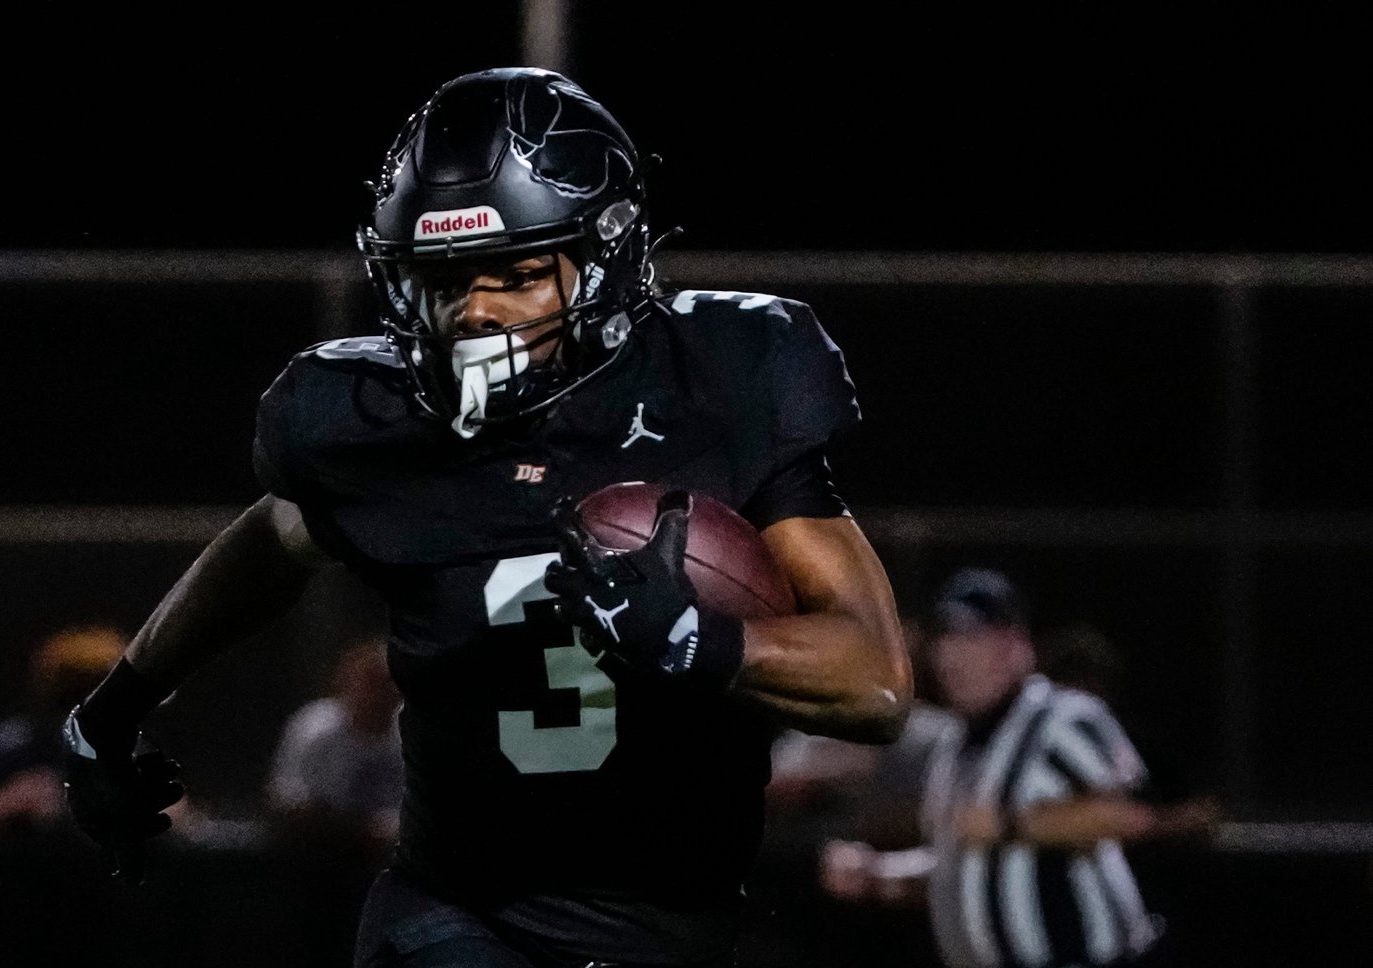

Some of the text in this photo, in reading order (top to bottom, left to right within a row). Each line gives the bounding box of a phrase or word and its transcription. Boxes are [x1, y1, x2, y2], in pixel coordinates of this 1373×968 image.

[421, 211, 489, 235] Riddell
[513, 462, 547, 485] DE
[483, 552, 618, 774] 3
